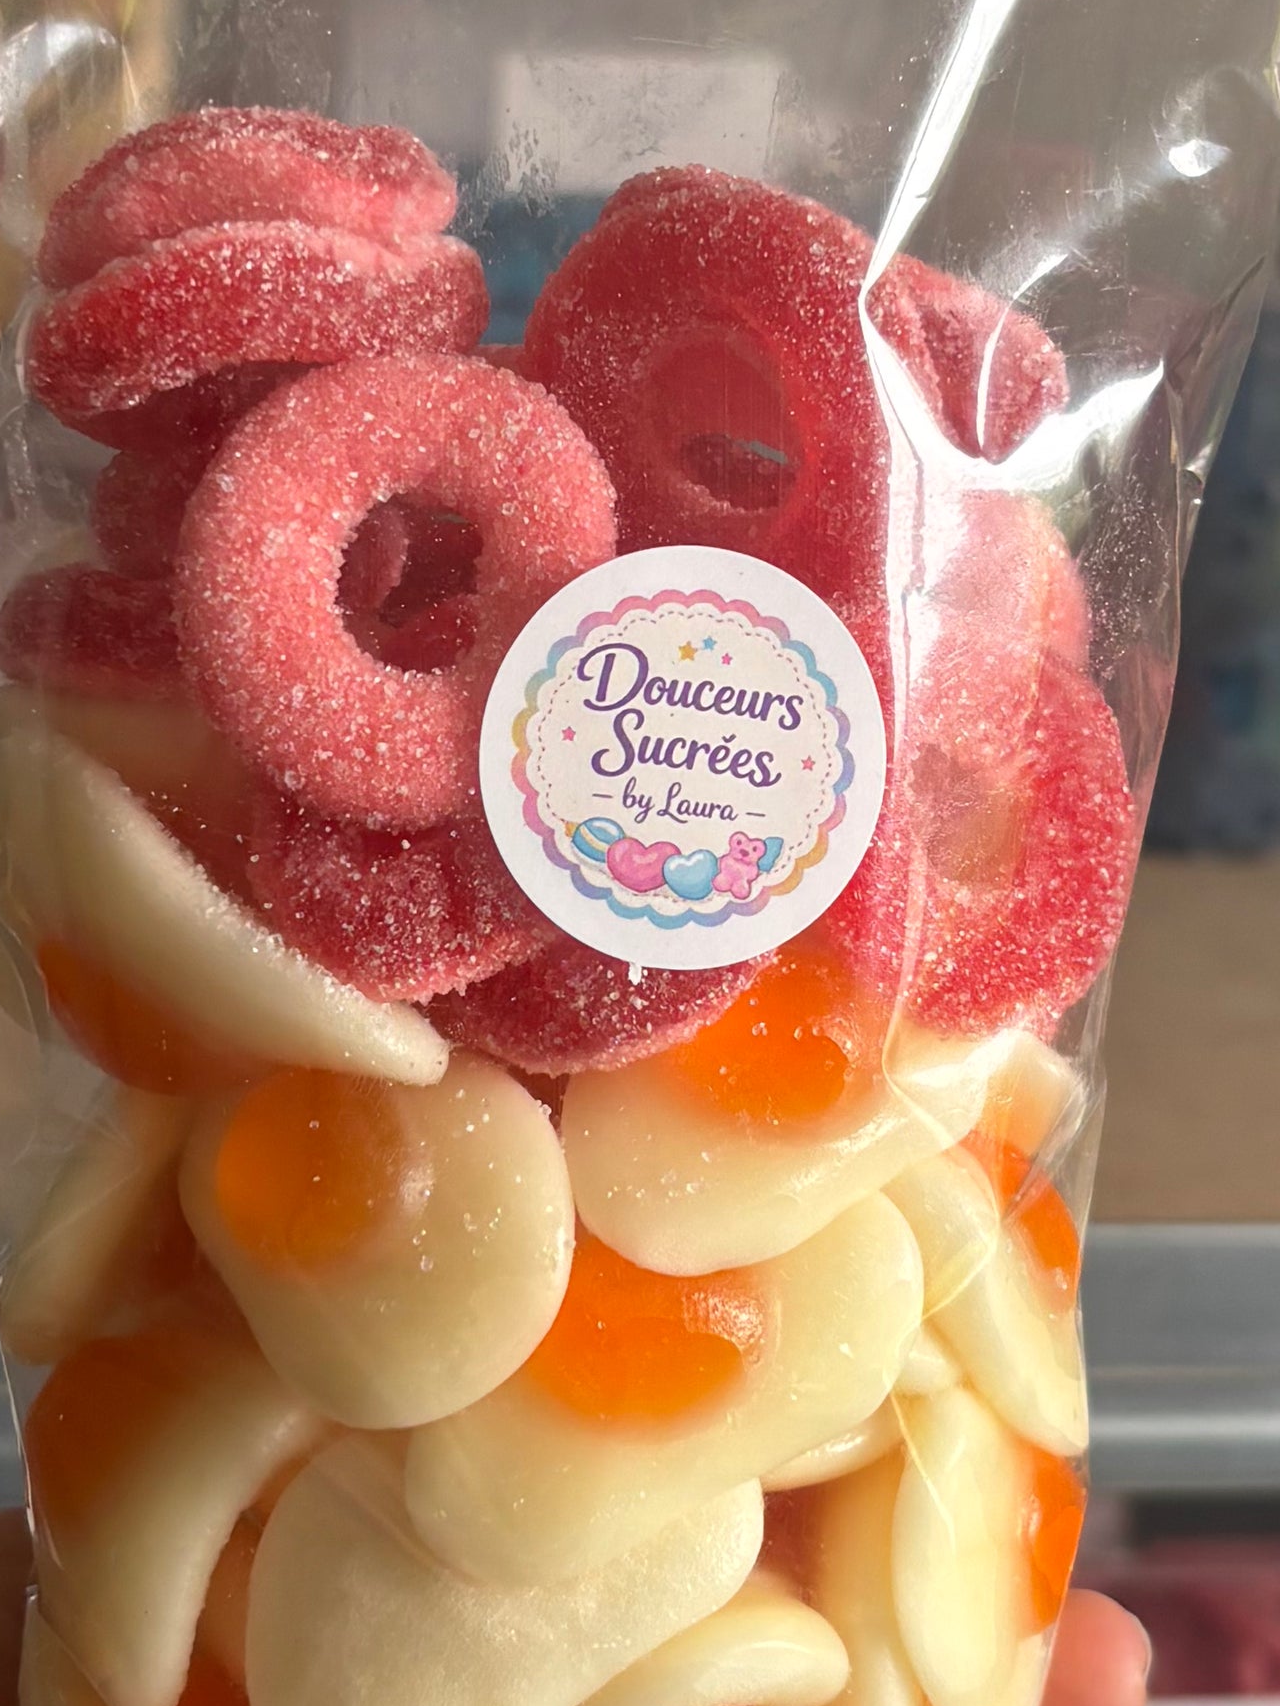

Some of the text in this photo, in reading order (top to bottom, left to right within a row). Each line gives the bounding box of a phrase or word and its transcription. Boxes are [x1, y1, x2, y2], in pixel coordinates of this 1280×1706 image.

[577, 643, 804, 730] Douceurs
[591, 708, 782, 788] Sucrées
[622, 776, 738, 824] by Laura
